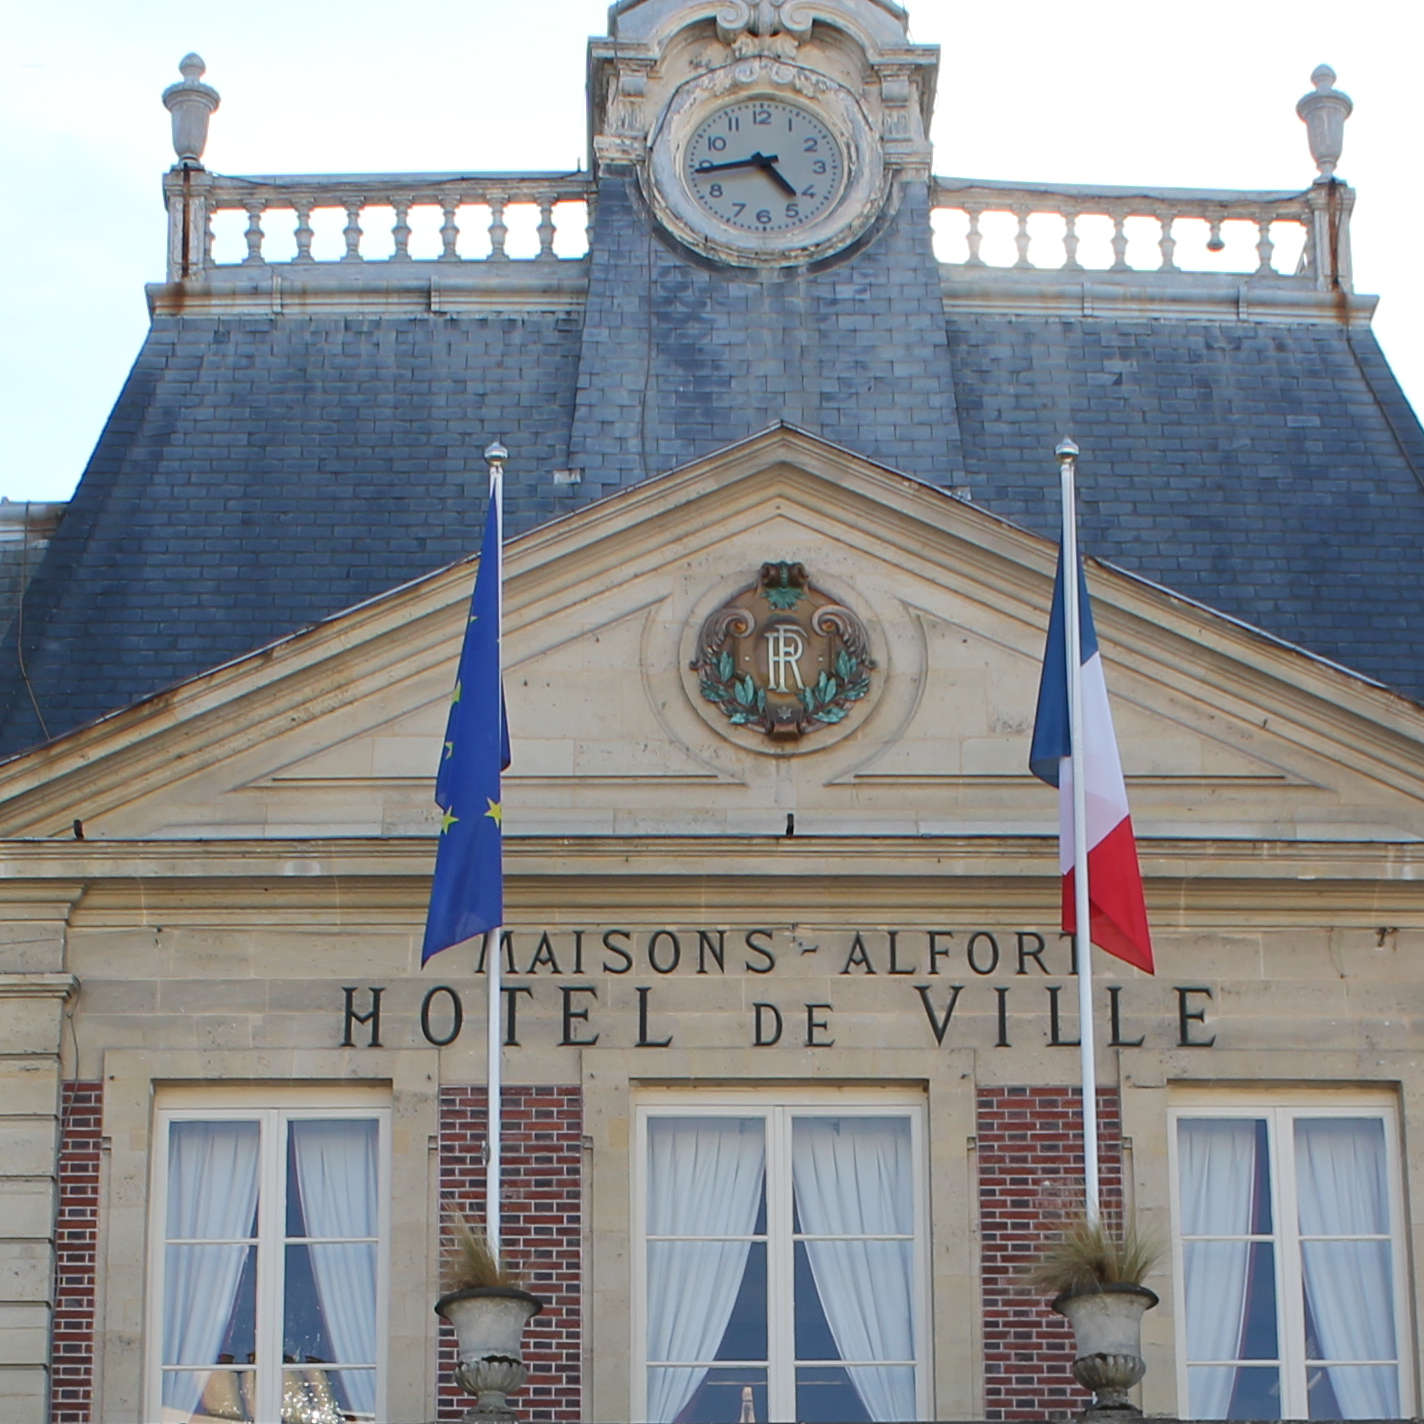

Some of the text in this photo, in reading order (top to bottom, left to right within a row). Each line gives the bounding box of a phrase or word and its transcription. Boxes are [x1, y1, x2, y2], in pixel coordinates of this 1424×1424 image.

[728, 117, 739, 132] 11
[753, 110, 772, 125] 12
[708, 136, 727, 151] 10
[803, 137, 818, 152] 2
[812, 160, 826, 175] 3
[709, 183, 723, 198] 8
[801, 184, 817, 199] 4
[732, 202, 747, 219] 7
[756, 209, 772, 224] 6
[785, 203, 799, 218] 5
[339, 985, 1217, 1048] HOTEL DE VILLE
